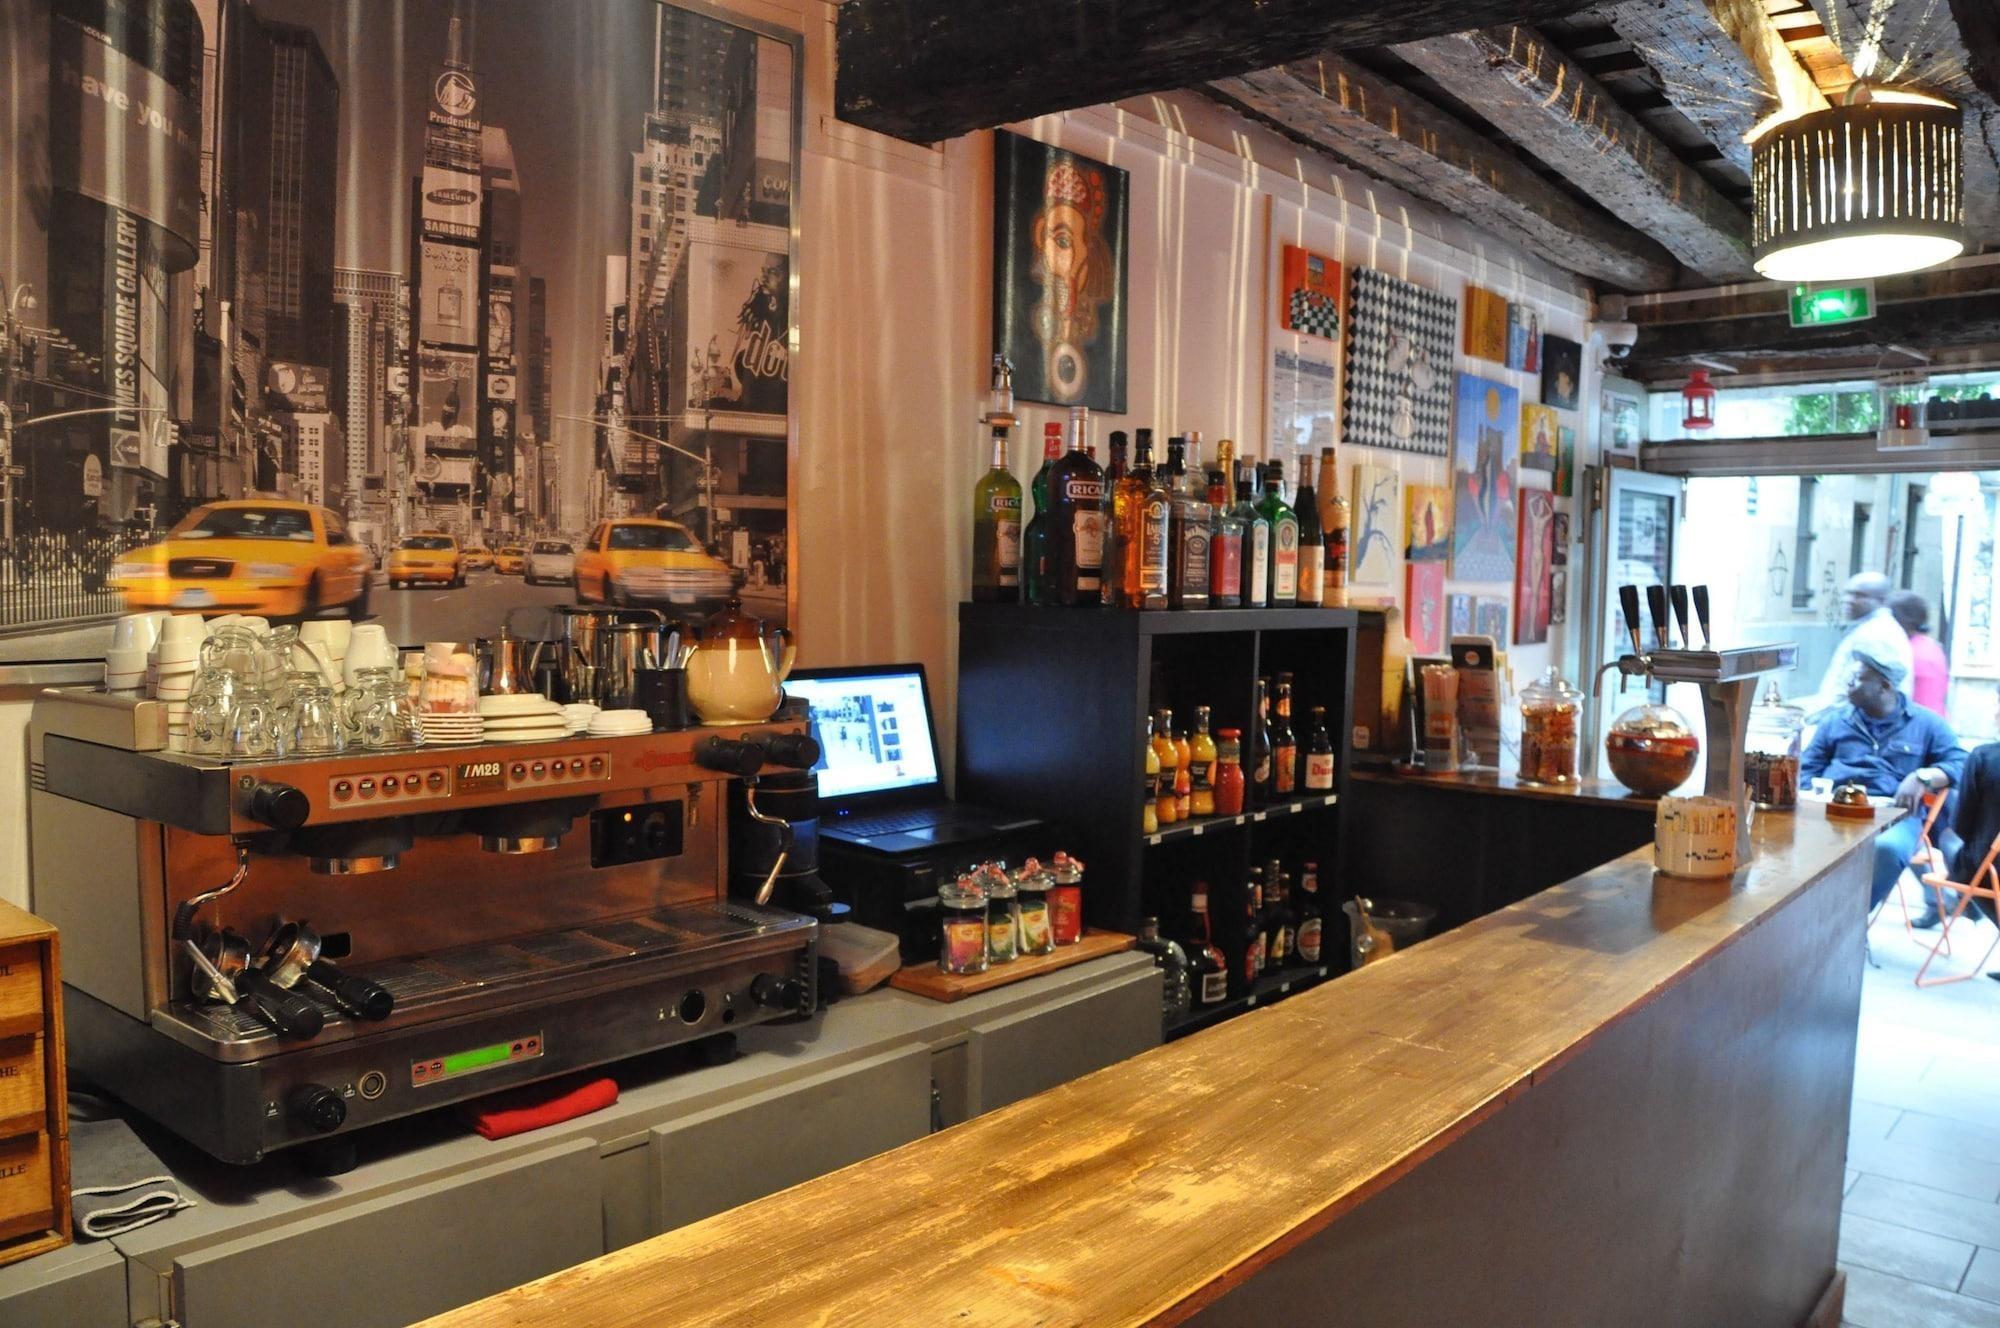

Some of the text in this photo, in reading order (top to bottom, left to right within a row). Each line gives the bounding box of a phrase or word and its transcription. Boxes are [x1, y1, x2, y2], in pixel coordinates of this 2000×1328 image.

[429, 110, 480, 130] Prudential
[116, 208, 137, 293] GALLERY
[424, 219, 478, 239] SAMSUNG
[115, 296, 137, 362] SQUARE
[115, 367, 136, 422] TIMES
